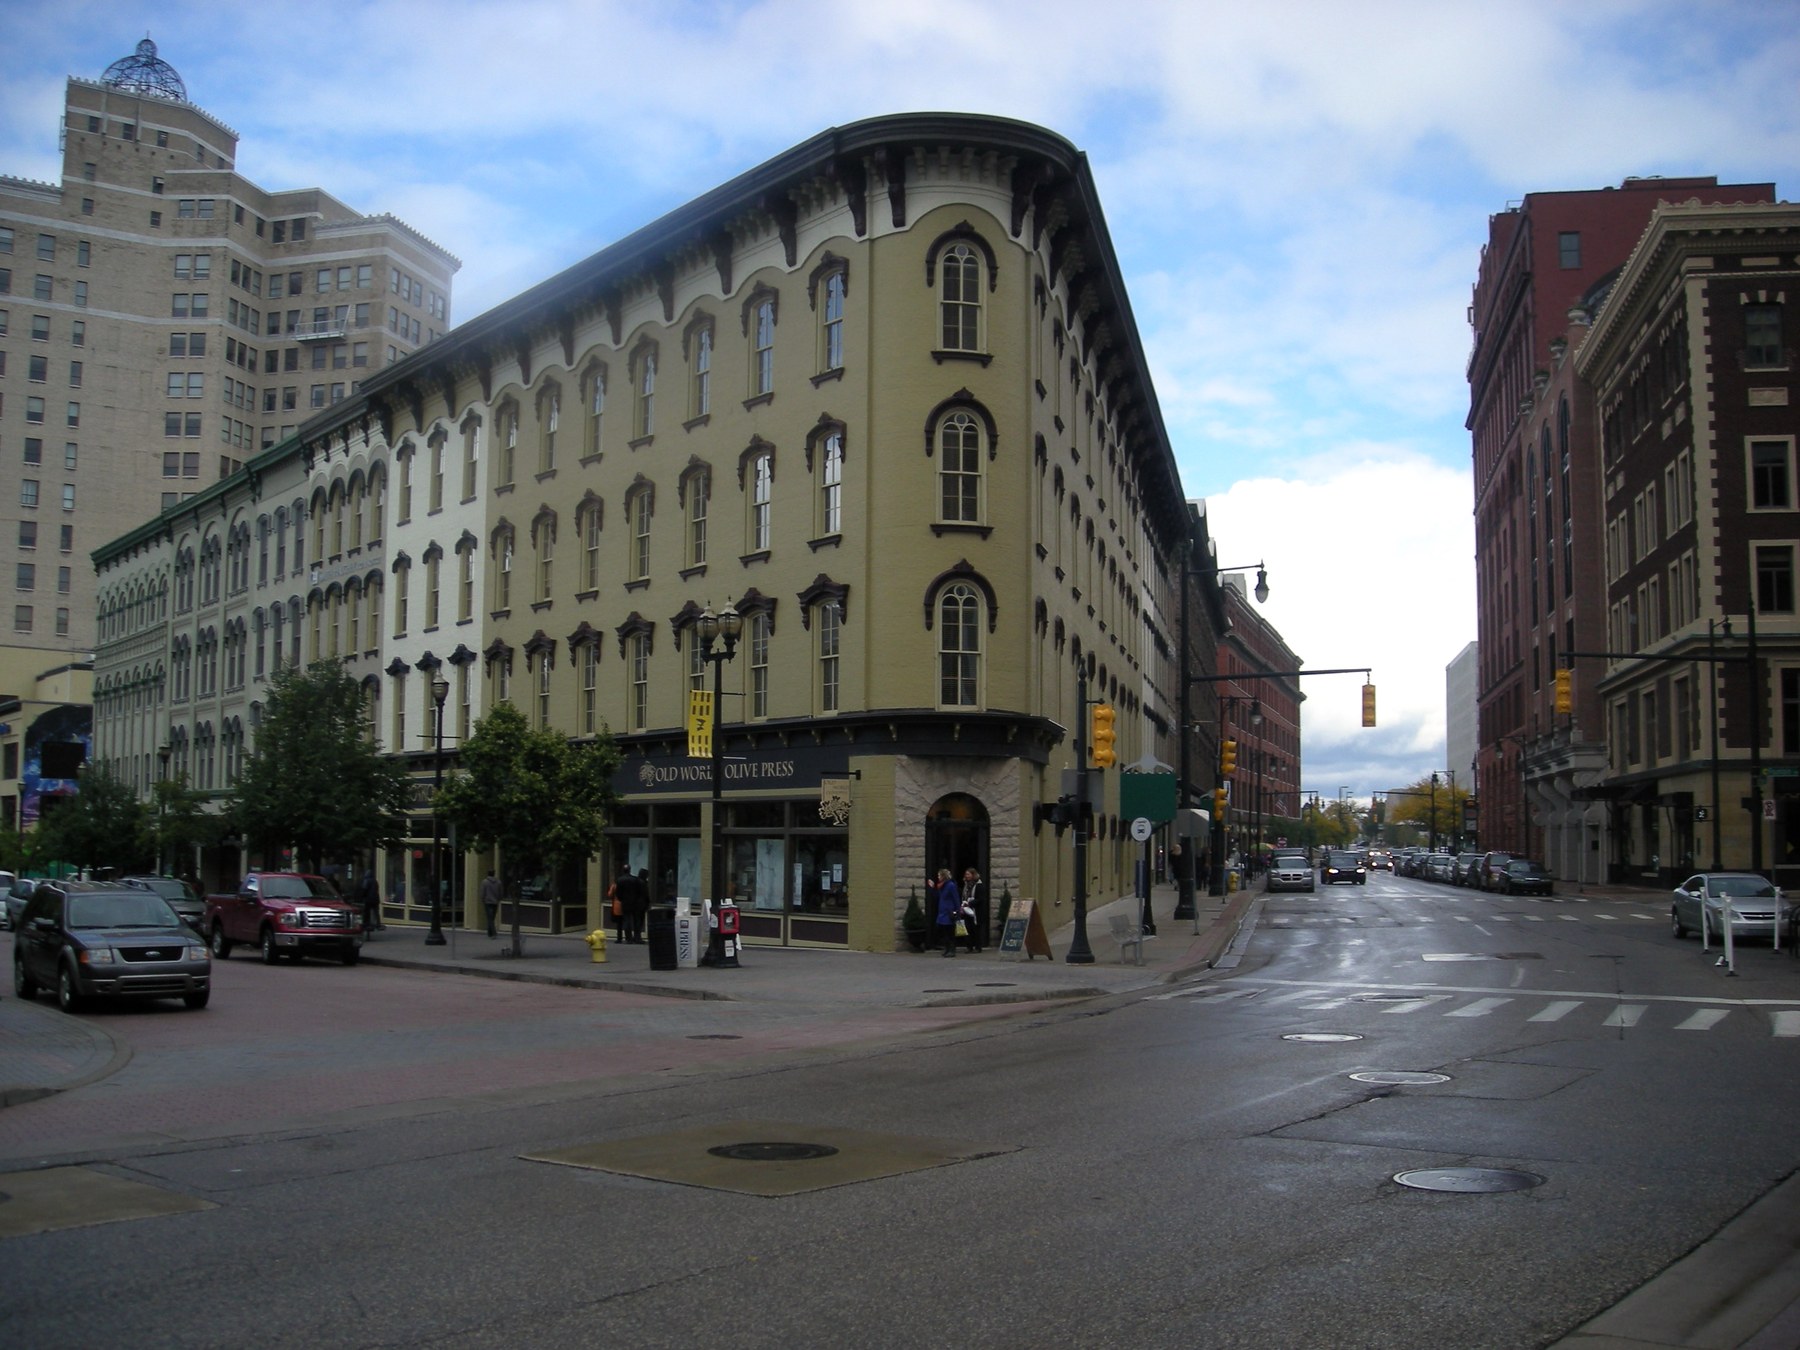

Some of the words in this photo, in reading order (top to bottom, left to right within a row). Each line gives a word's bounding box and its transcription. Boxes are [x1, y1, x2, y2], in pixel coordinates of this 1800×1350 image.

[655, 767, 678, 782] OLD
[680, 765, 713, 781] WORL
[724, 763, 759, 779] OLIVE
[761, 760, 795, 777] PRESS
[680, 930, 691, 961] PRESS
